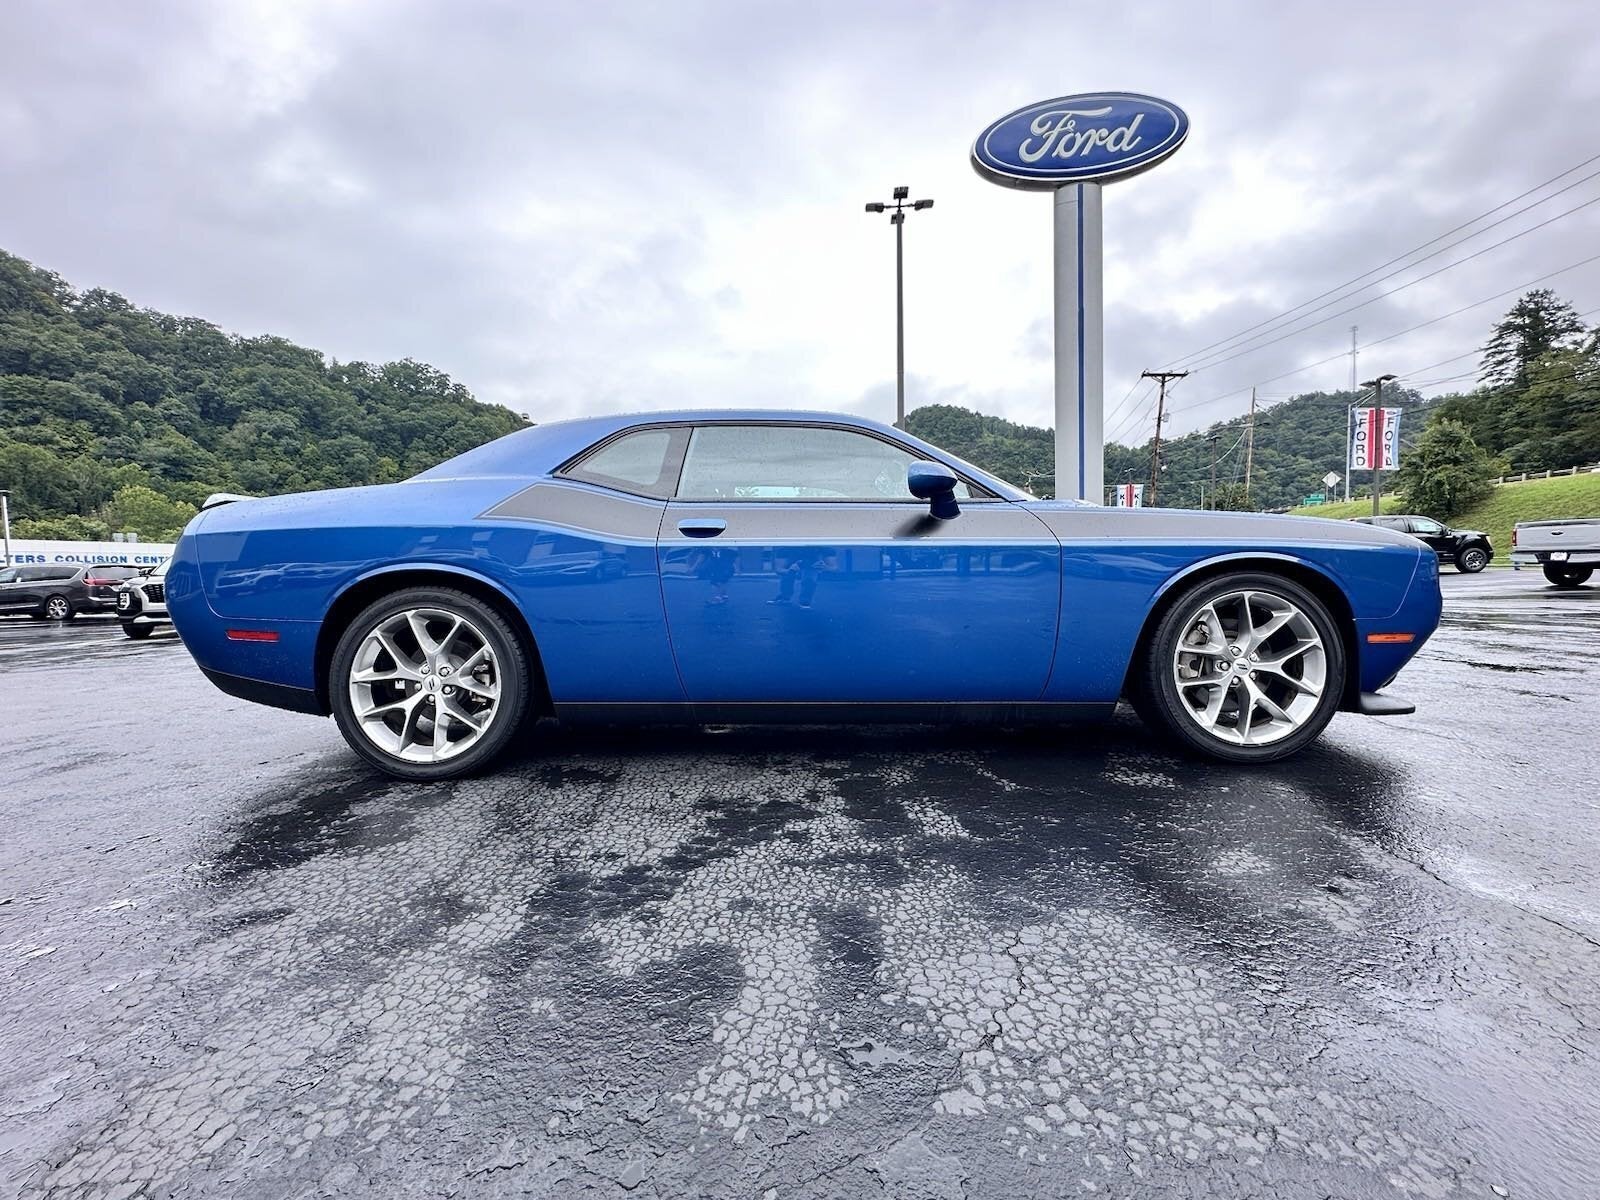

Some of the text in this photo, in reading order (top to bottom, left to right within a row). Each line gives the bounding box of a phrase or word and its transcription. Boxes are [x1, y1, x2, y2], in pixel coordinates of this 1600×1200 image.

[1018, 106, 1144, 163] Ford
[1356, 418, 1367, 466] FORD
[54, 554, 128, 564] COLLISION
[134, 555, 168, 564] CENT
